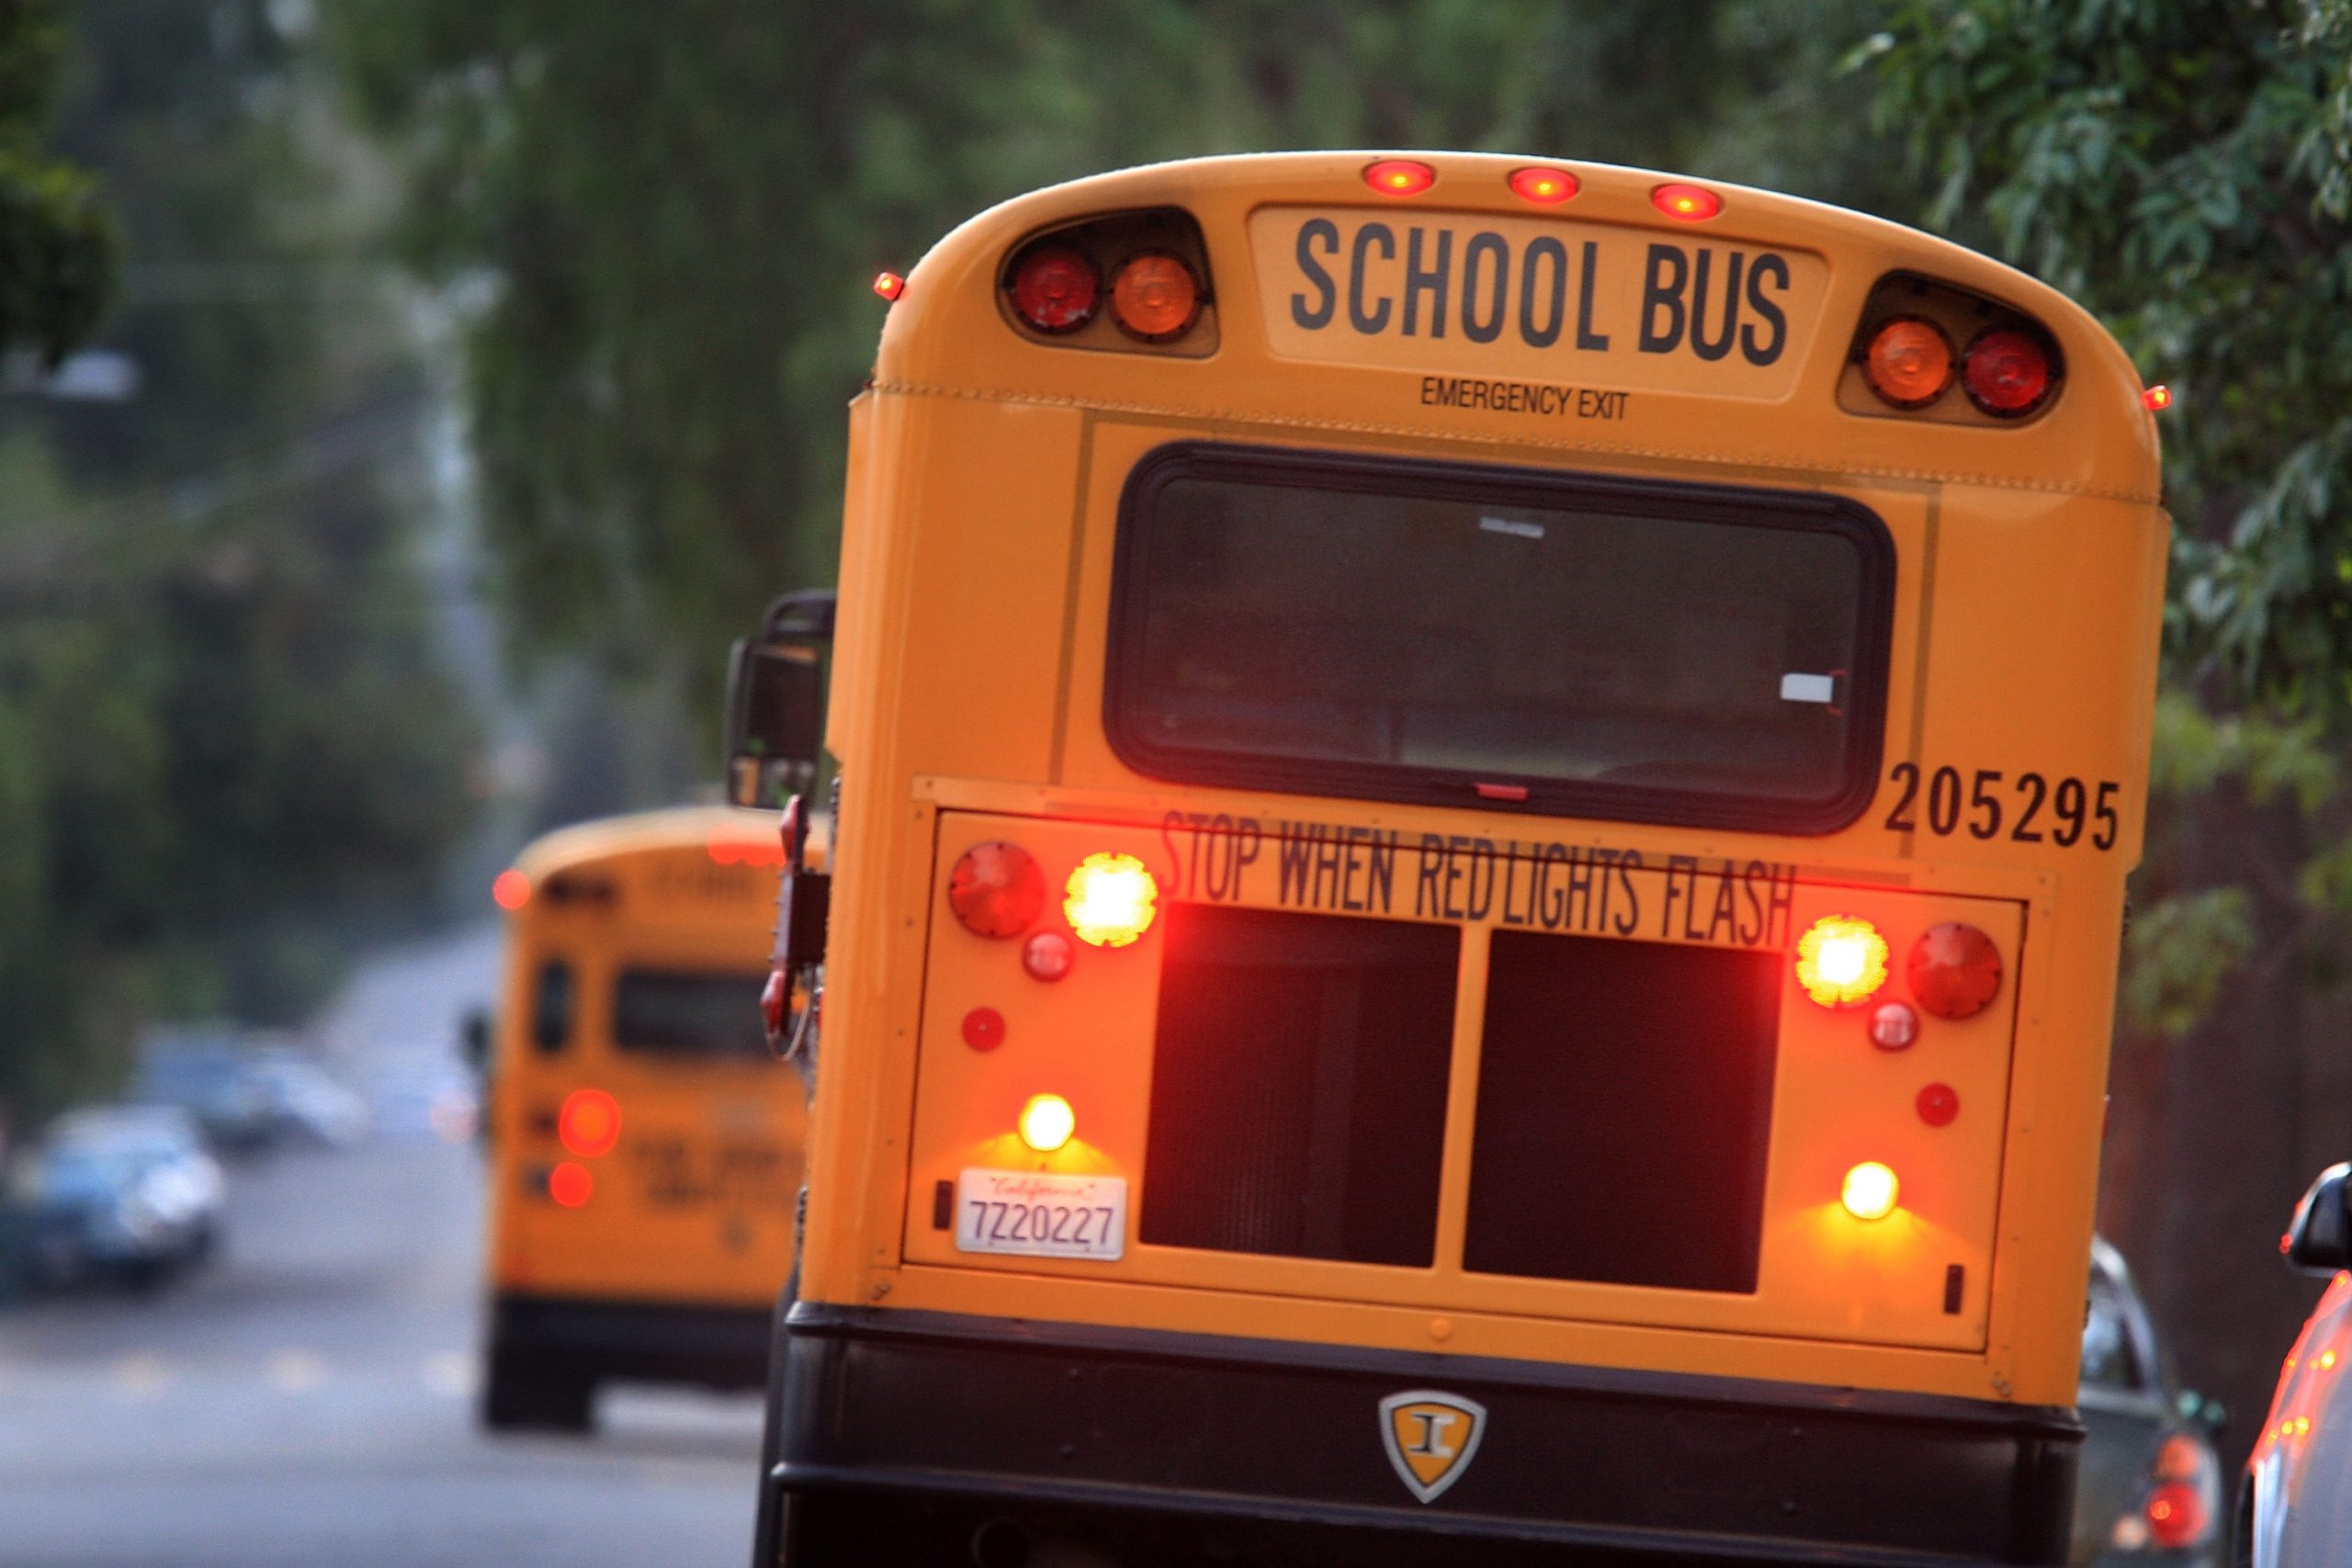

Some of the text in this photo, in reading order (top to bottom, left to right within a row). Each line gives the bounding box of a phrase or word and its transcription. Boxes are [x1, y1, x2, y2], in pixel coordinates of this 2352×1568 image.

[1290, 218, 1791, 367] SCHOOL BUS
[1421, 377, 1630, 420] EMERGENCY EXIT
[1885, 761, 2120, 852] 205295
[1159, 809, 1796, 947] STOP WHEN RED LIGHTS FLASH
[969, 1201, 1114, 1245] 7Z20227
